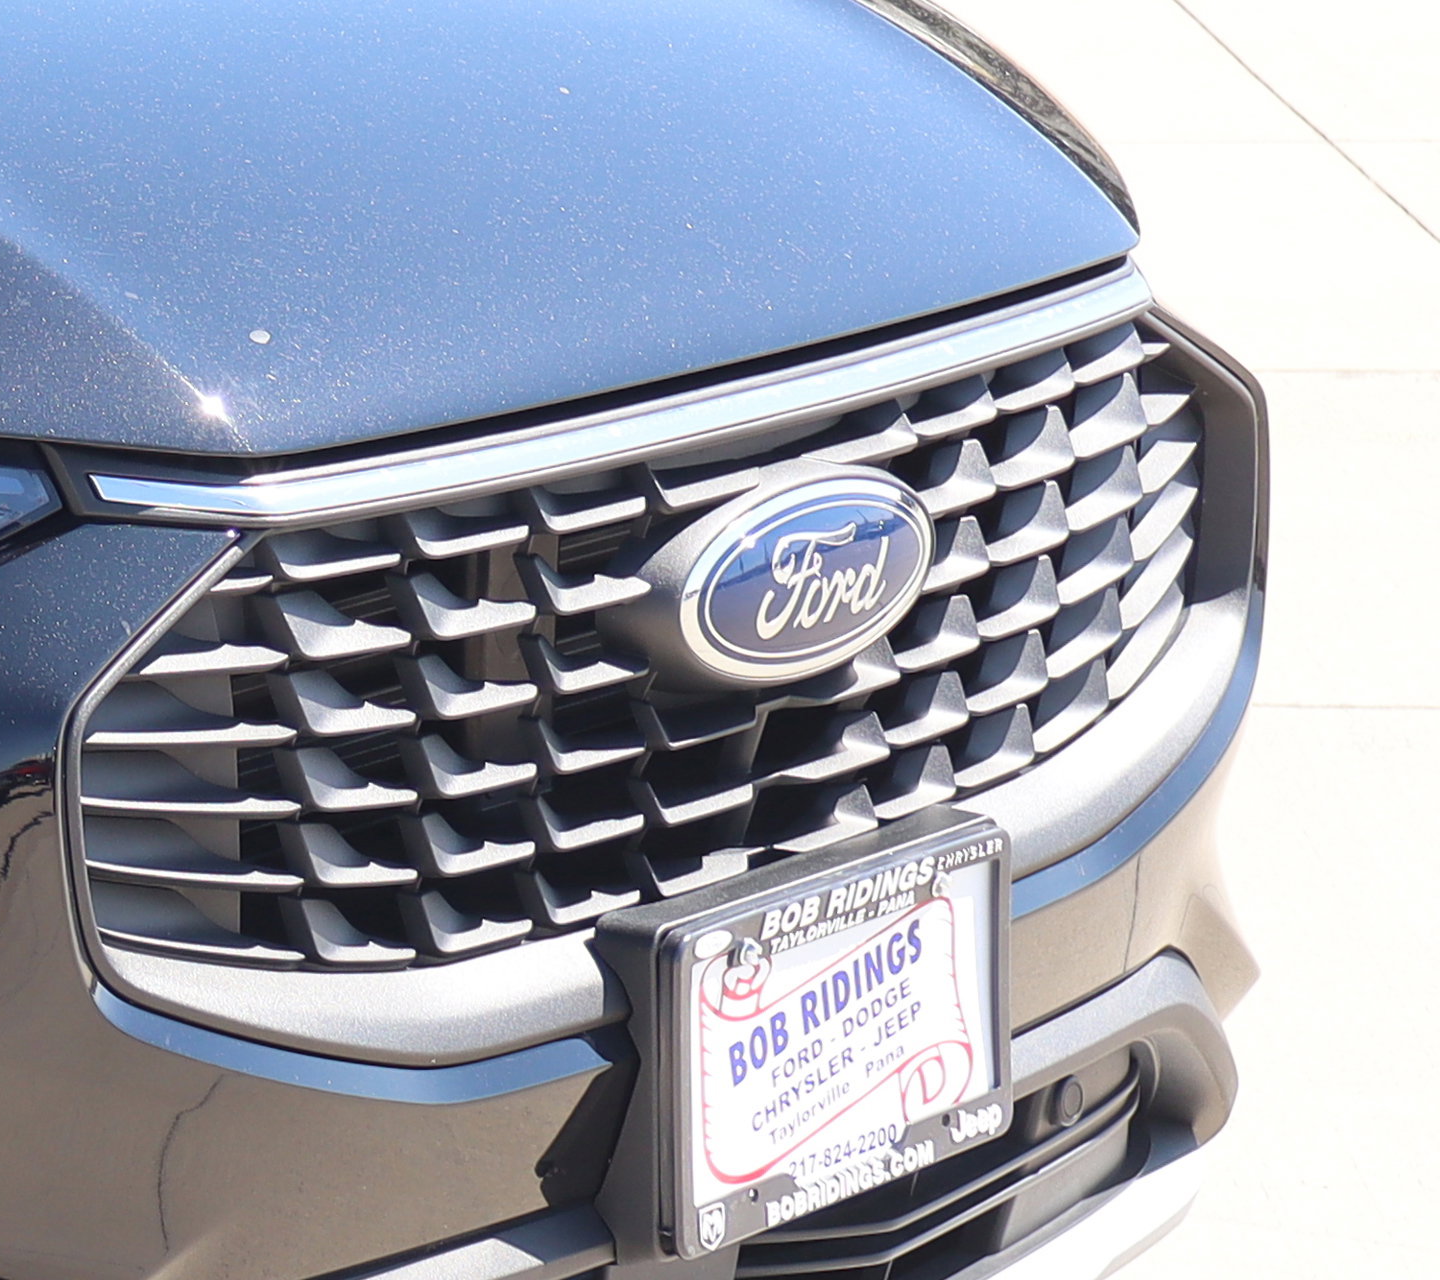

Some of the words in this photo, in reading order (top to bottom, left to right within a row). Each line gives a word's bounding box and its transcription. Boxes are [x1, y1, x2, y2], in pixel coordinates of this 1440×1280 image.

[755, 520, 890, 640] Ford
[761, 894, 821, 942] BOB
[826, 854, 938, 919] RIDINGS
[937, 838, 1004, 871] CHRYSLER
[769, 908, 869, 955] TAYLORVILLE
[877, 890, 916, 918] PANA
[728, 1010, 790, 1088] BOB
[800, 918, 923, 1036] RIDINGS
[771, 1037, 824, 1088] FORD
[841, 977, 913, 1038] DODGE
[750, 1045, 855, 1132] CHRYSLER
[873, 1000, 923, 1048] JEEP
[768, 1079, 851, 1145] Taylorville
[864, 1043, 906, 1079] Pana
[788, 1122, 898, 1180] 217-824-2200
[949, 1103, 1003, 1144] Jeep
[765, 1139, 935, 1228] BOBRIDINGS.COM
